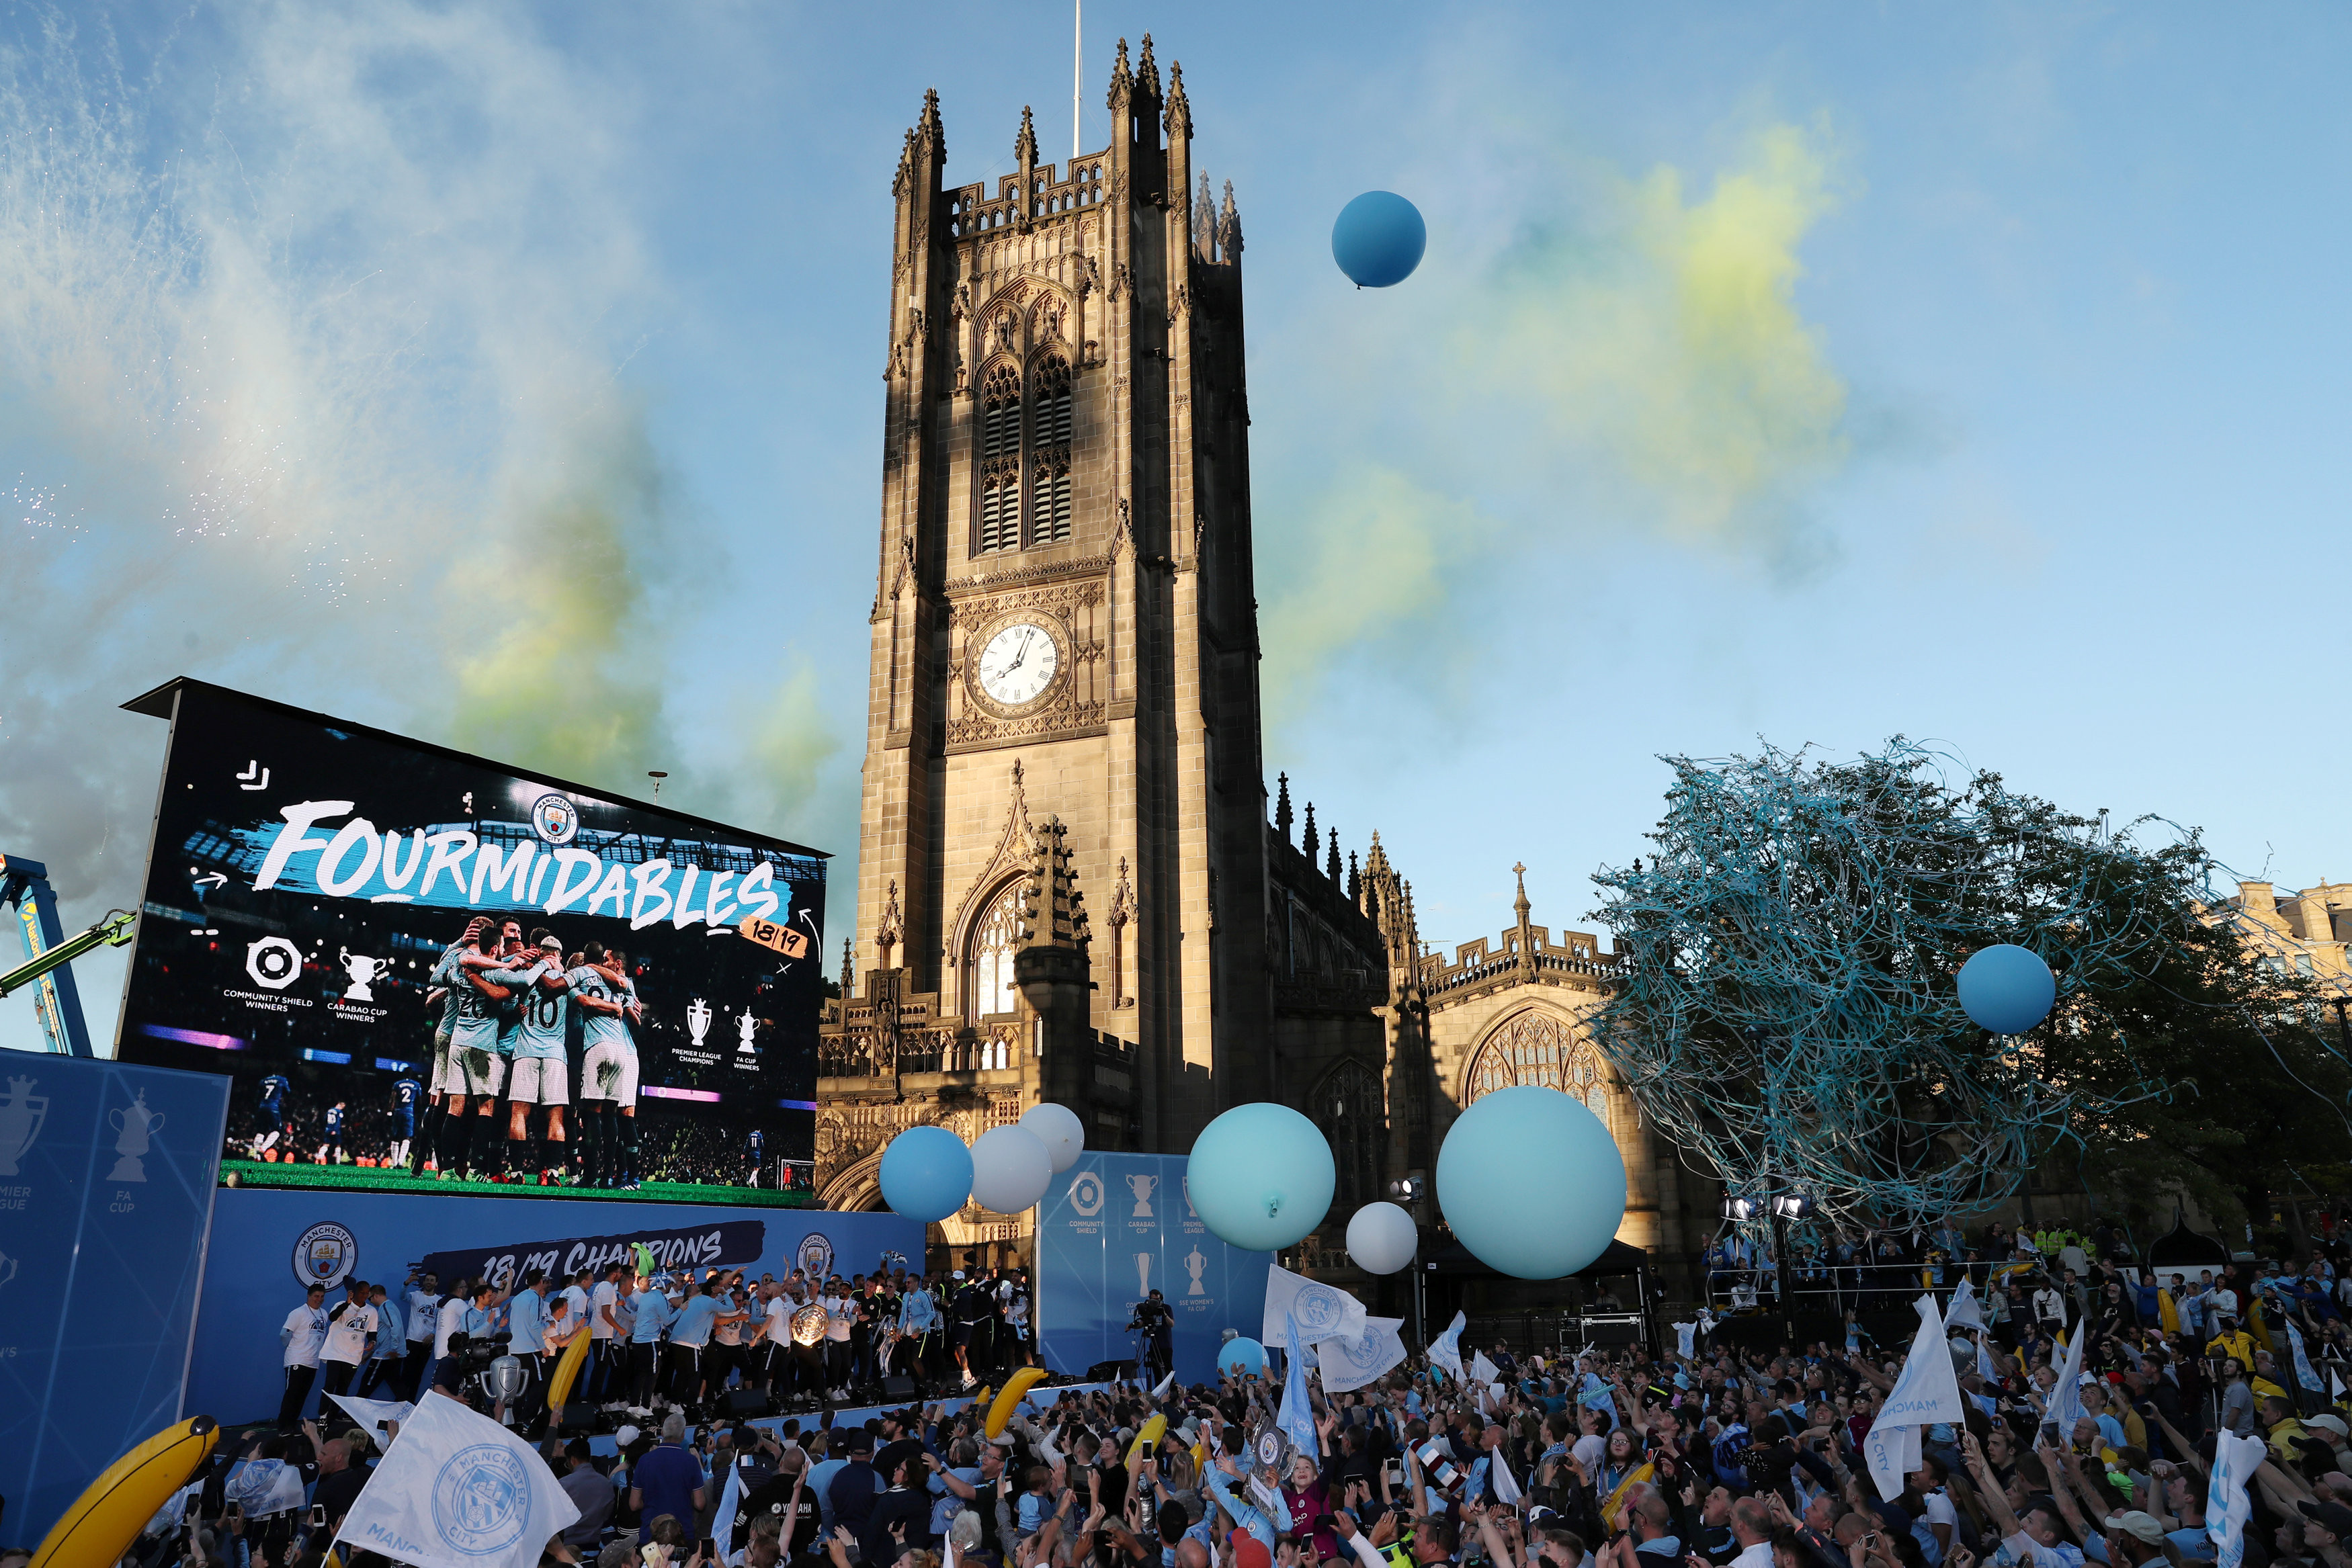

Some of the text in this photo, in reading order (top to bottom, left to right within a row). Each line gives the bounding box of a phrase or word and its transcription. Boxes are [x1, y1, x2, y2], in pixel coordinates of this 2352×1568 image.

[538, 797, 575, 818] MANCHESTER
[251, 799, 779, 931] FOURMIDABLES
[223, 989, 313, 1007] COMMUNITY SHIELD
[245, 1000, 288, 1012] WINNERS
[327, 1002, 388, 1016] CARABAO CUP
[528, 994, 558, 1029] 10
[336, 1012, 375, 1023] WINNERS
[672, 1048, 722, 1060] PREMIER LEAGUE
[679, 1055, 714, 1065] CHAMPIONS
[733, 1063, 759, 1072] WINNERS
[265, 1085, 275, 1100] 7
[401, 1088, 411, 1102] 2
[751, 1137, 757, 1148] 11
[116, 1190, 131, 1201] FA
[109, 1203, 134, 1213] CUP
[301, 1227, 351, 1248] MANCHESTER
[800, 1236, 830, 1253] MANCHESTER
[1300, 1287, 1338, 1307] MANCHESTER
[1276, 1333, 1331, 1342] MACHESTER
[1334, 1351, 1394, 1385] MANCHESTER CITY
[1874, 1443, 1890, 1471] CITY
[459, 1452, 526, 1506] MANCHESTER
[366, 1522, 431, 1557] MANC
[449, 1526, 477, 1547] CITY
